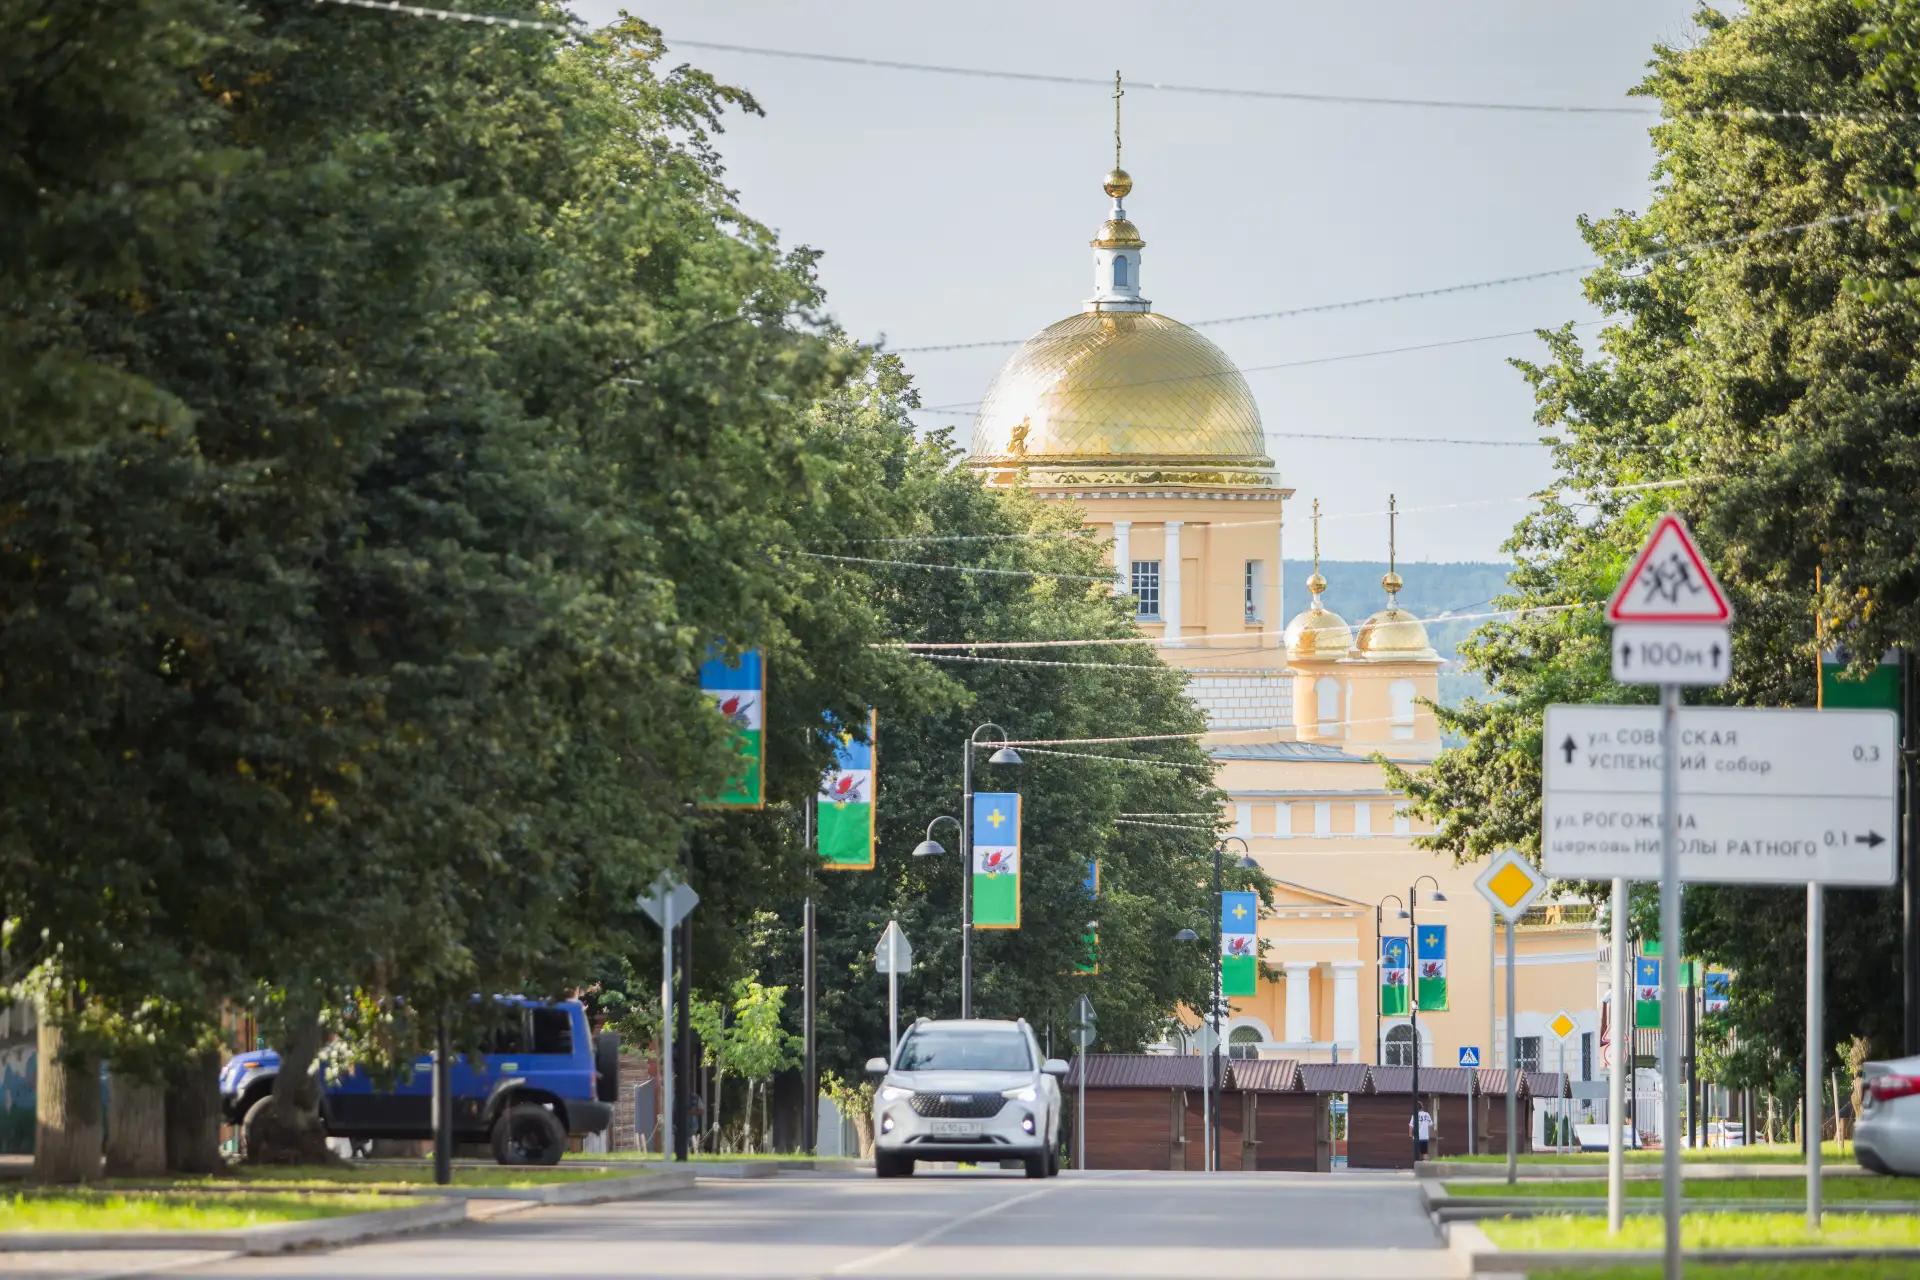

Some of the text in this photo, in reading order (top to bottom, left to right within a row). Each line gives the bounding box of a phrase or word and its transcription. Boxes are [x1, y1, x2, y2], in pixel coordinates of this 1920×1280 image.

[1641, 643, 1703, 666] 100м
[1587, 728, 1738, 747] ул. СОВСКАЯ
[1587, 752, 1772, 774] УСПЕНСИЙ собор
[1552, 838, 1817, 856] церковь НИОЛЫ РАТНОГО
